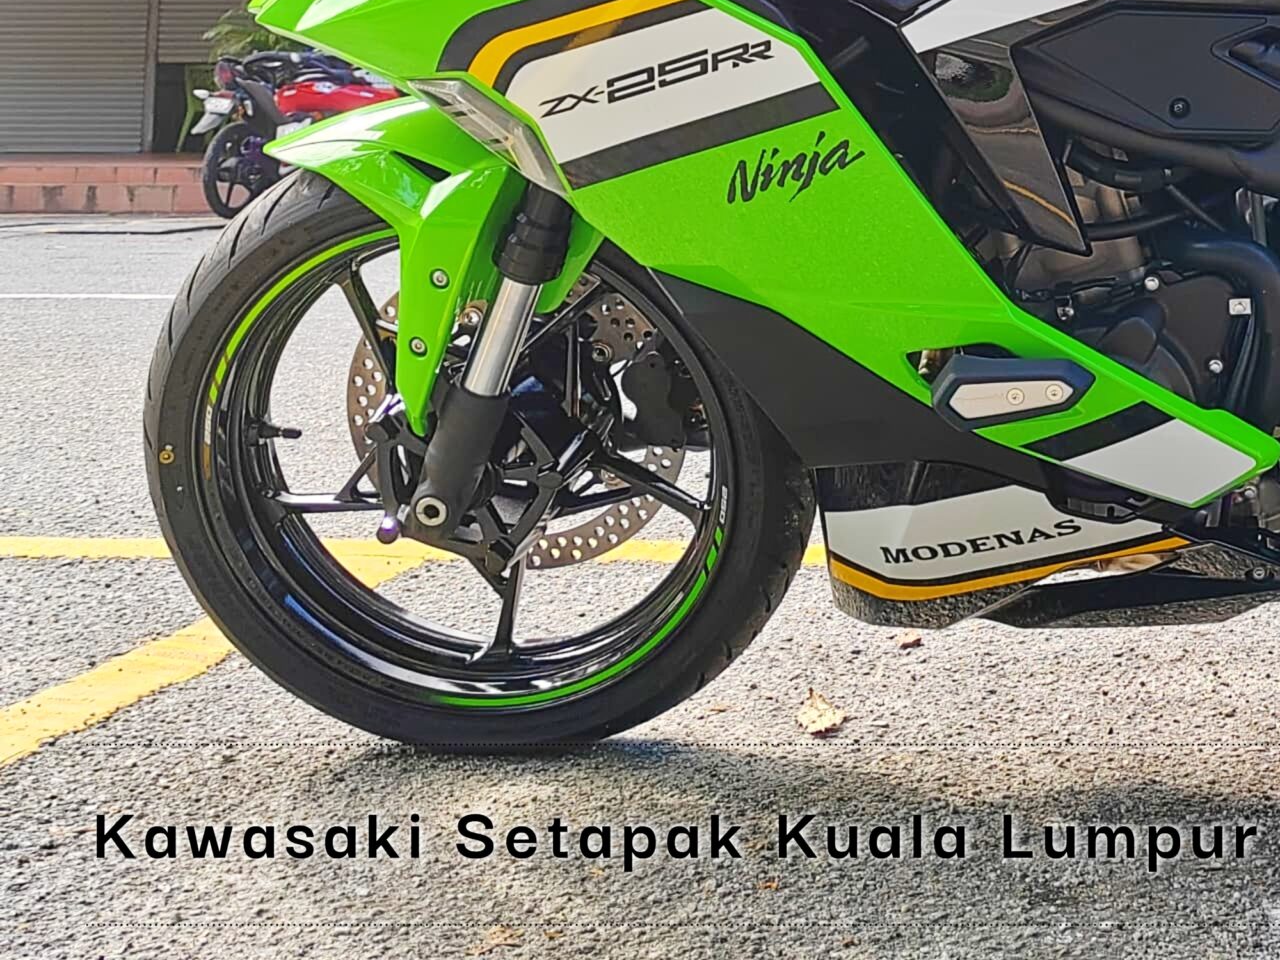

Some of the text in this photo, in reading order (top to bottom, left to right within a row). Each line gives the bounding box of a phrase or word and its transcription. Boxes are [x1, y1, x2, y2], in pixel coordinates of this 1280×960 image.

[538, 40, 775, 119] ZX-25RR
[727, 131, 865, 204] Ninja
[880, 519, 1082, 564] MODENAS
